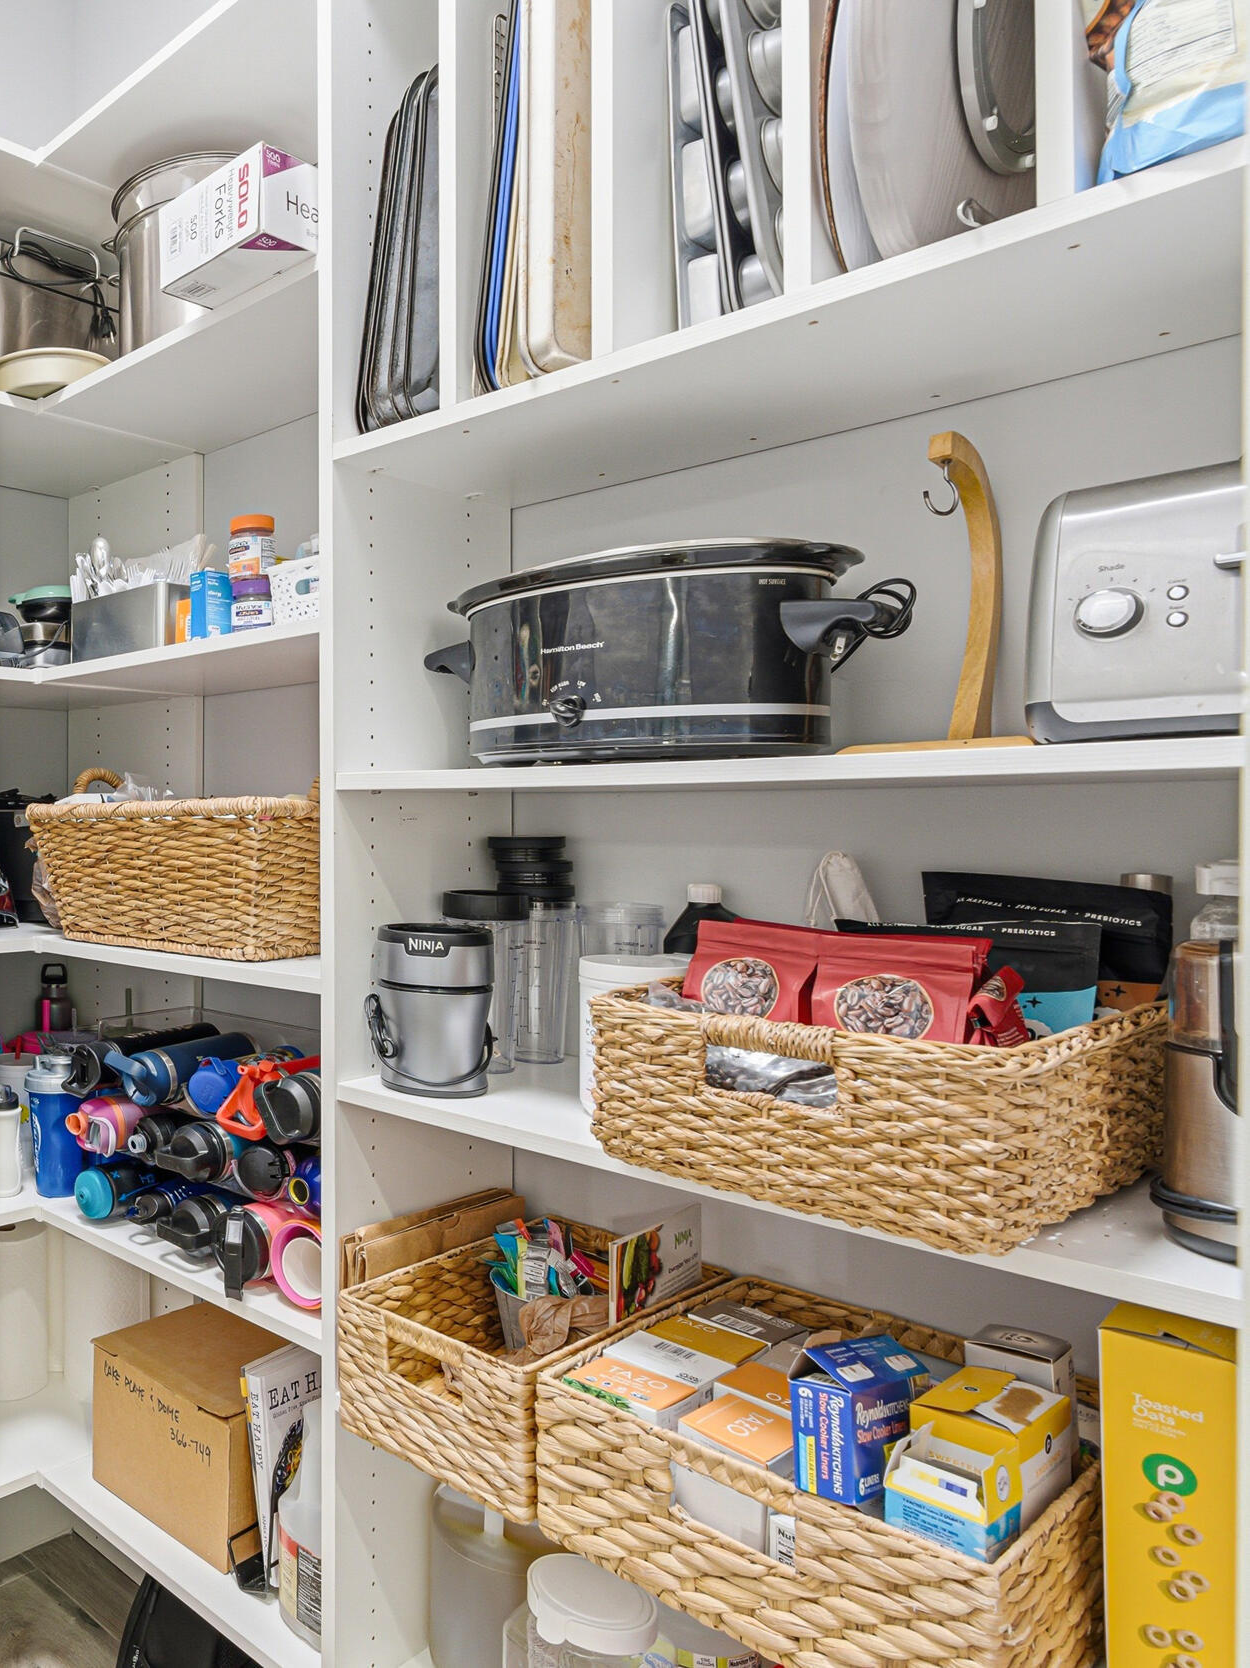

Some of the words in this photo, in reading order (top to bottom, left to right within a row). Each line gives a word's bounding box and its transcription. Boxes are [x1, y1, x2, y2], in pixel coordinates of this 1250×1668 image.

[237, 162, 249, 229] SOLO
[286, 190, 318, 224] Hea
[214, 183, 227, 239] Forks
[190, 214, 198, 241] 500
[540, 644, 575, 655] Hamilton
[575, 641, 605, 651] Beach
[1001, 927, 1056, 937] PREBIOTICS
[1084, 912, 1142, 927] PREBIOTICS
[408, 937, 445, 954] NINJA
[676, 1317, 718, 1333] TAZO
[609, 1364, 668, 1391] TAZO
[104, 1360, 120, 1386] CAKE
[125, 1375, 145, 1400] PLATE
[157, 1399, 180, 1424] DOME
[250, 1391, 260, 1419] EAT
[268, 1380, 300, 1410] EAT
[819, 1391, 829, 1417] Slow
[829, 1393, 845, 1449] Reynolds
[855, 1400, 886, 1429] Reynolds
[1132, 1391, 1204, 1424] Toasted
[1132, 1403, 1175, 1427] Oats
[726, 1412, 774, 1437] TAZO
[819, 1417, 829, 1450] Cooker
[856, 1426, 872, 1444] Slow
[170, 1427, 212, 1467] 366-749
[253, 1423, 264, 1470] HAPPY
[820, 1451, 829, 1480] Liners
[831, 1448, 844, 1497] KITCHENS
[858, 1477, 865, 1497] 6
